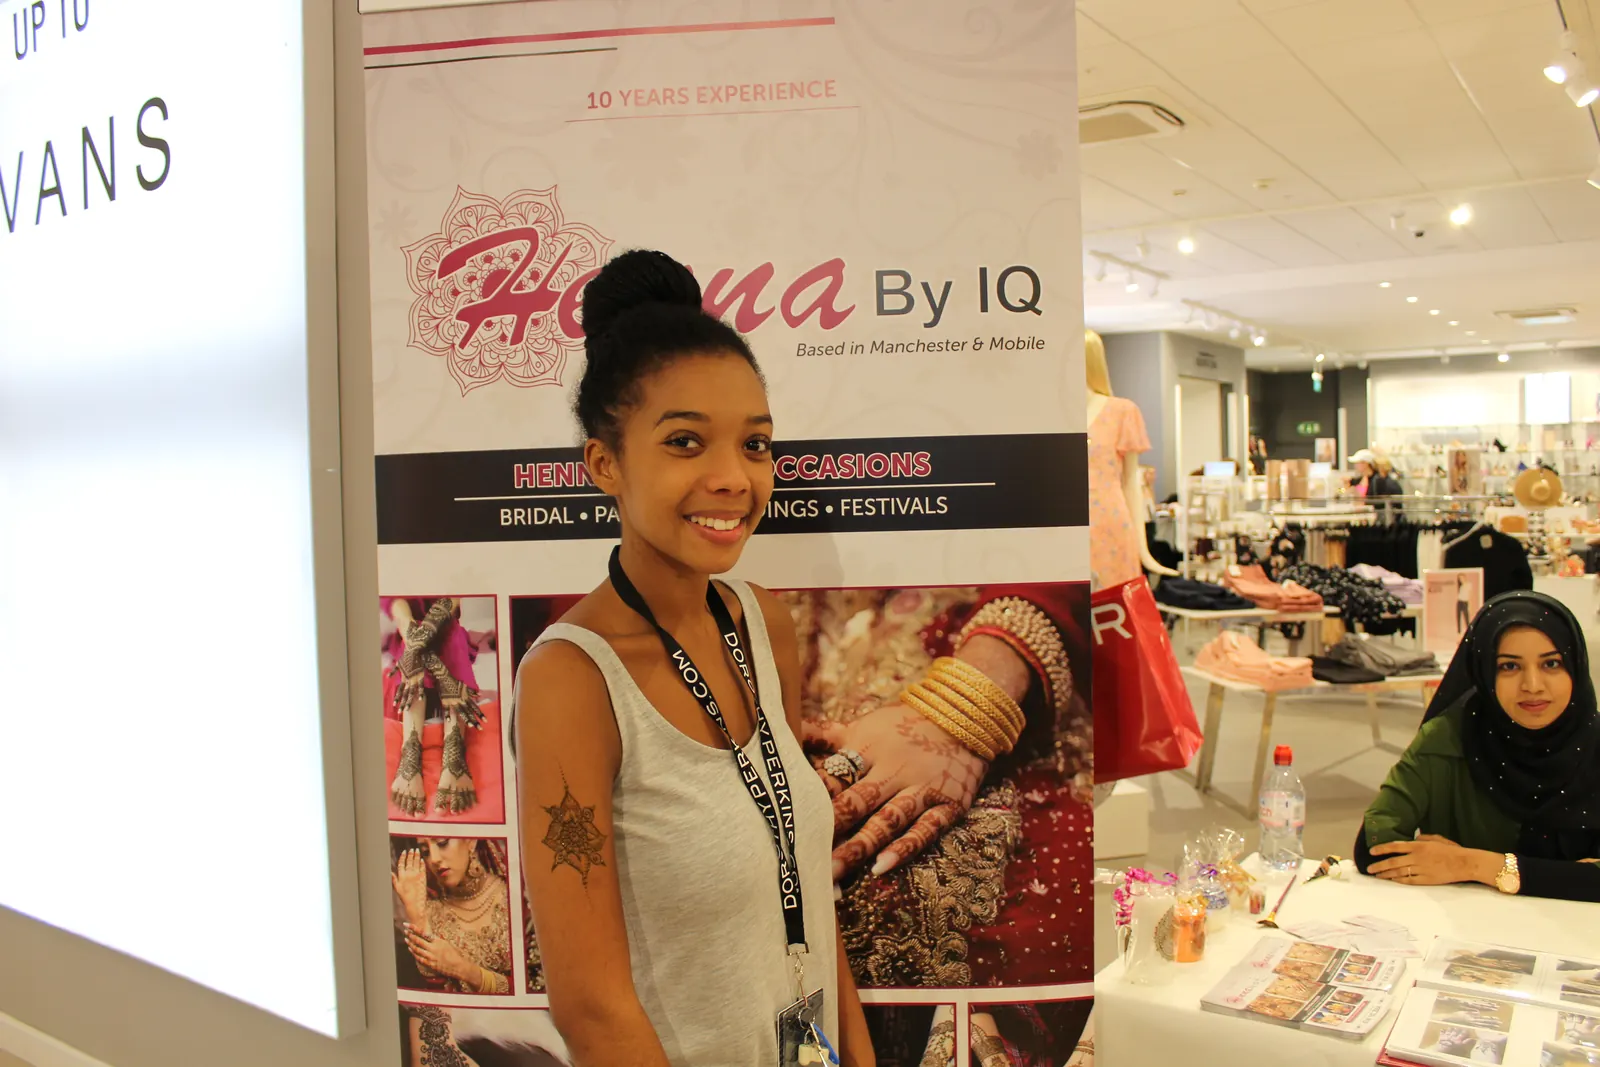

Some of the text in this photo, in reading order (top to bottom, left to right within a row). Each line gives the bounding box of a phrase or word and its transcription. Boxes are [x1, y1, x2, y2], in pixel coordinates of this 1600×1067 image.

[13, 0, 46, 60] UP
[587, 80, 837, 109] 10 YEARS EXPERIENCE
[875, 269, 953, 328] By
[978, 265, 1042, 316] IQ
[796, 335, 1046, 356] Based in Manchester & Mobile
[513, 451, 932, 488] HENN CCASIONS
[499, 507, 573, 526] BRIDAL
[595, 505, 622, 524] PA
[840, 496, 948, 517] FESTIVALS
